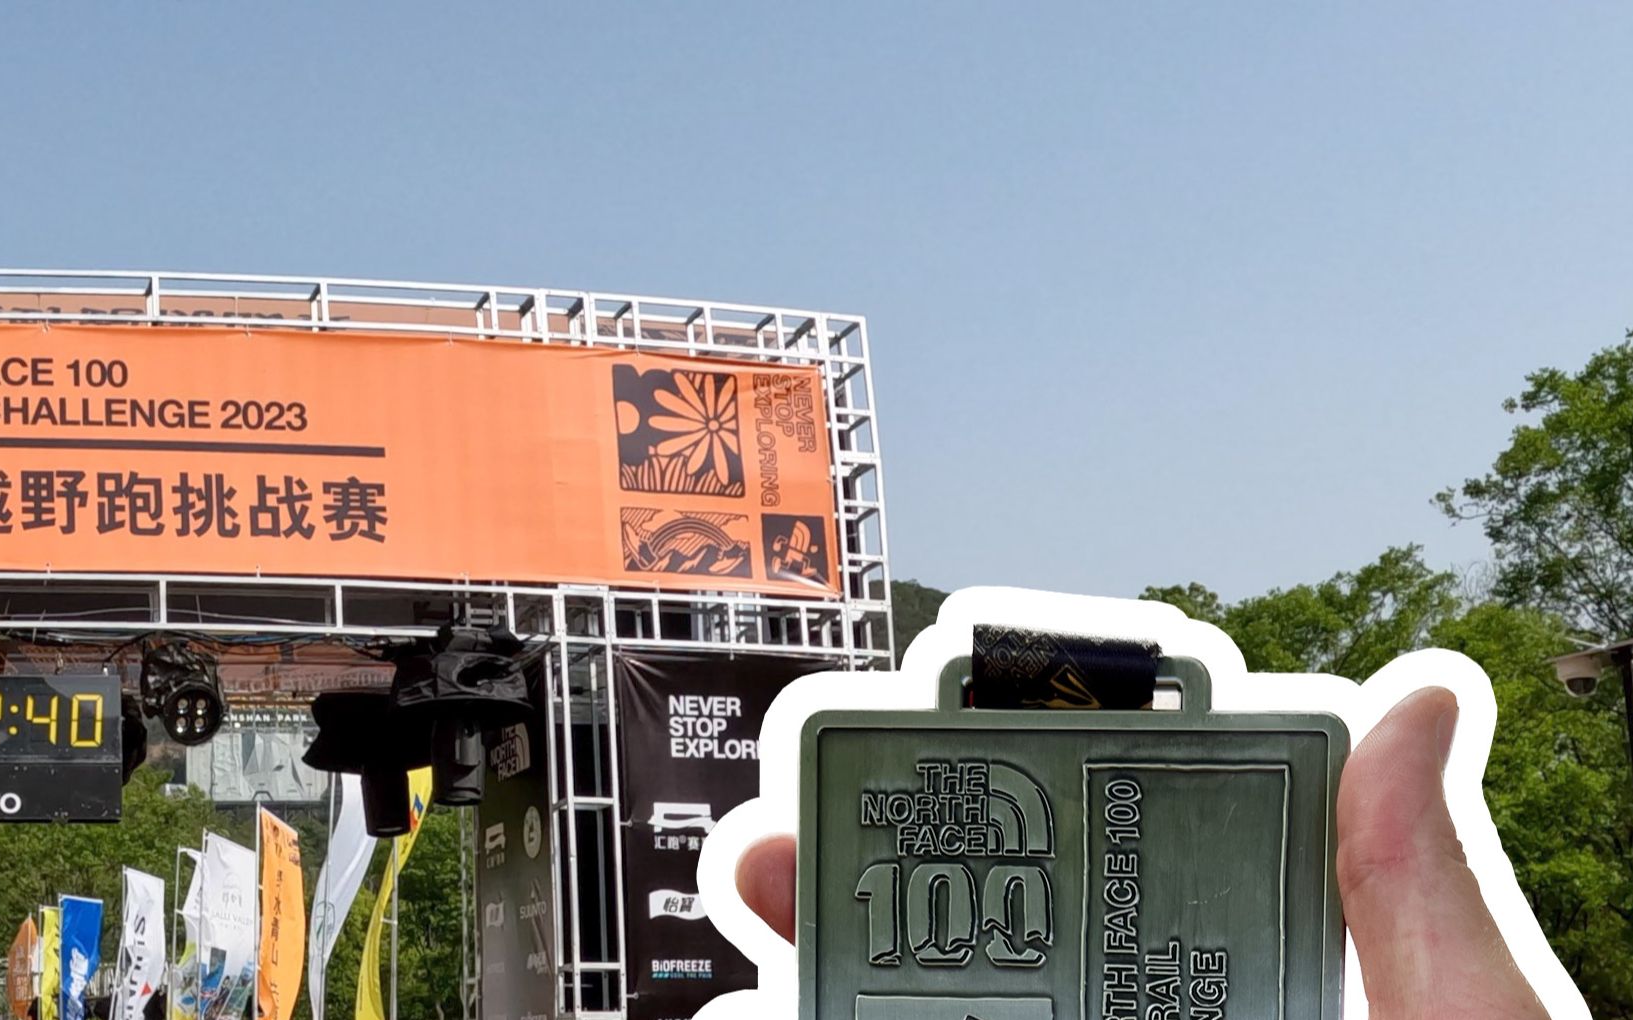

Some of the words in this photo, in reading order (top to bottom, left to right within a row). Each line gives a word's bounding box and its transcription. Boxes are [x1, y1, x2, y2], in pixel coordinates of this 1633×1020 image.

[66, 359, 128, 388] 100
[220, 401, 307, 432] 2023
[772, 374, 794, 437] STOP
[793, 375, 816, 453] NEVER
[753, 373, 781, 507] EXPLORING
[277, 714, 308, 722] PARK
[668, 695, 741, 717] NEVER
[669, 717, 727, 737] STOP
[670, 737, 760, 759] EXPLORI
[498, 757, 518, 782] FACE
[917, 762, 988, 795] THE
[861, 794, 989, 826] NORTH
[1104, 779, 1143, 841] 100
[897, 826, 988, 856] FACE
[520, 901, 546, 919] SUUNTO
[855, 863, 1054, 967] 100
[1103, 852, 1141, 954] FACE
